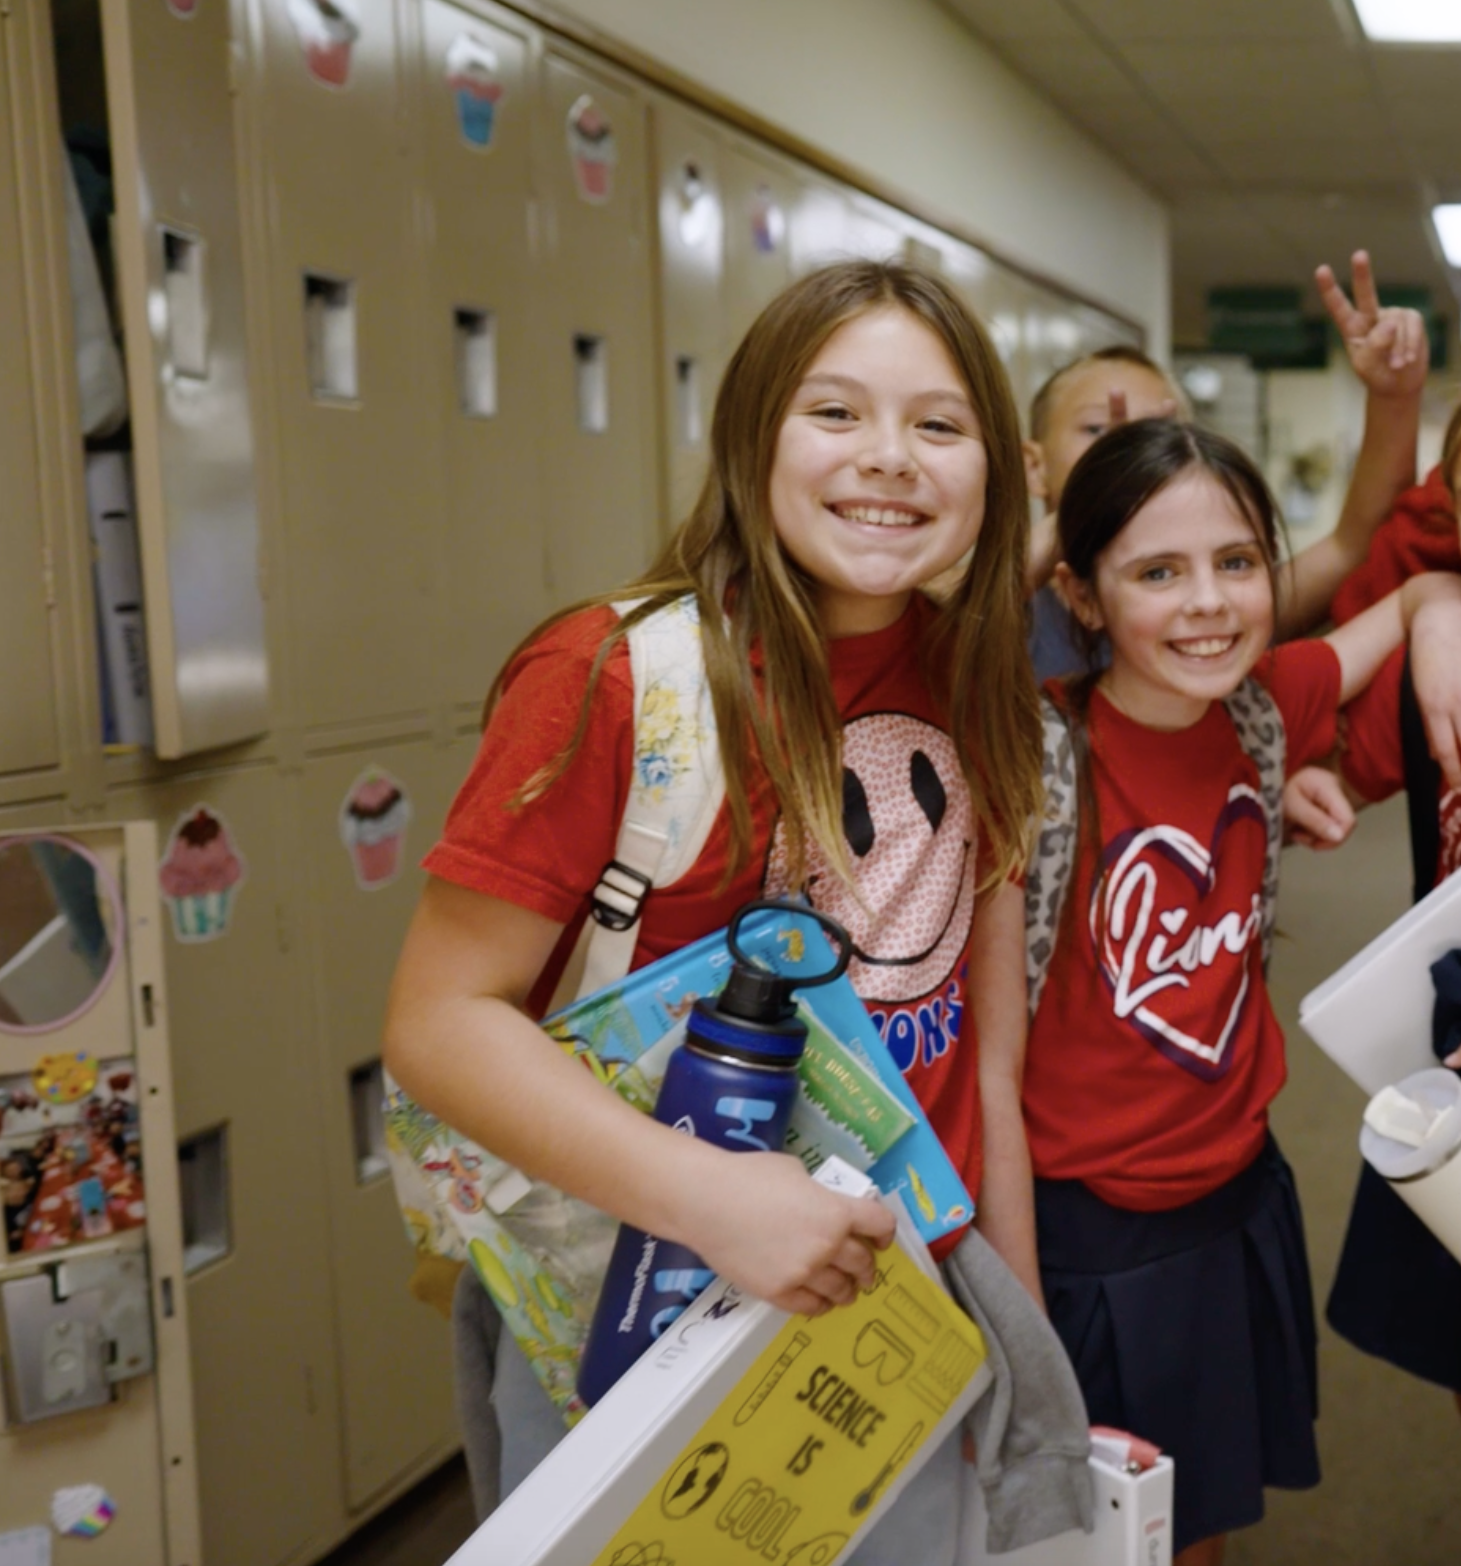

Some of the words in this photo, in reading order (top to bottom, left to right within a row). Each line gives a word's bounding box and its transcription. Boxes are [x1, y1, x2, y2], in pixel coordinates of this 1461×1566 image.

[795, 1365, 886, 1448] SCIENCE
[786, 1434, 824, 1476] IS
[715, 1477, 802, 1562] COOL
